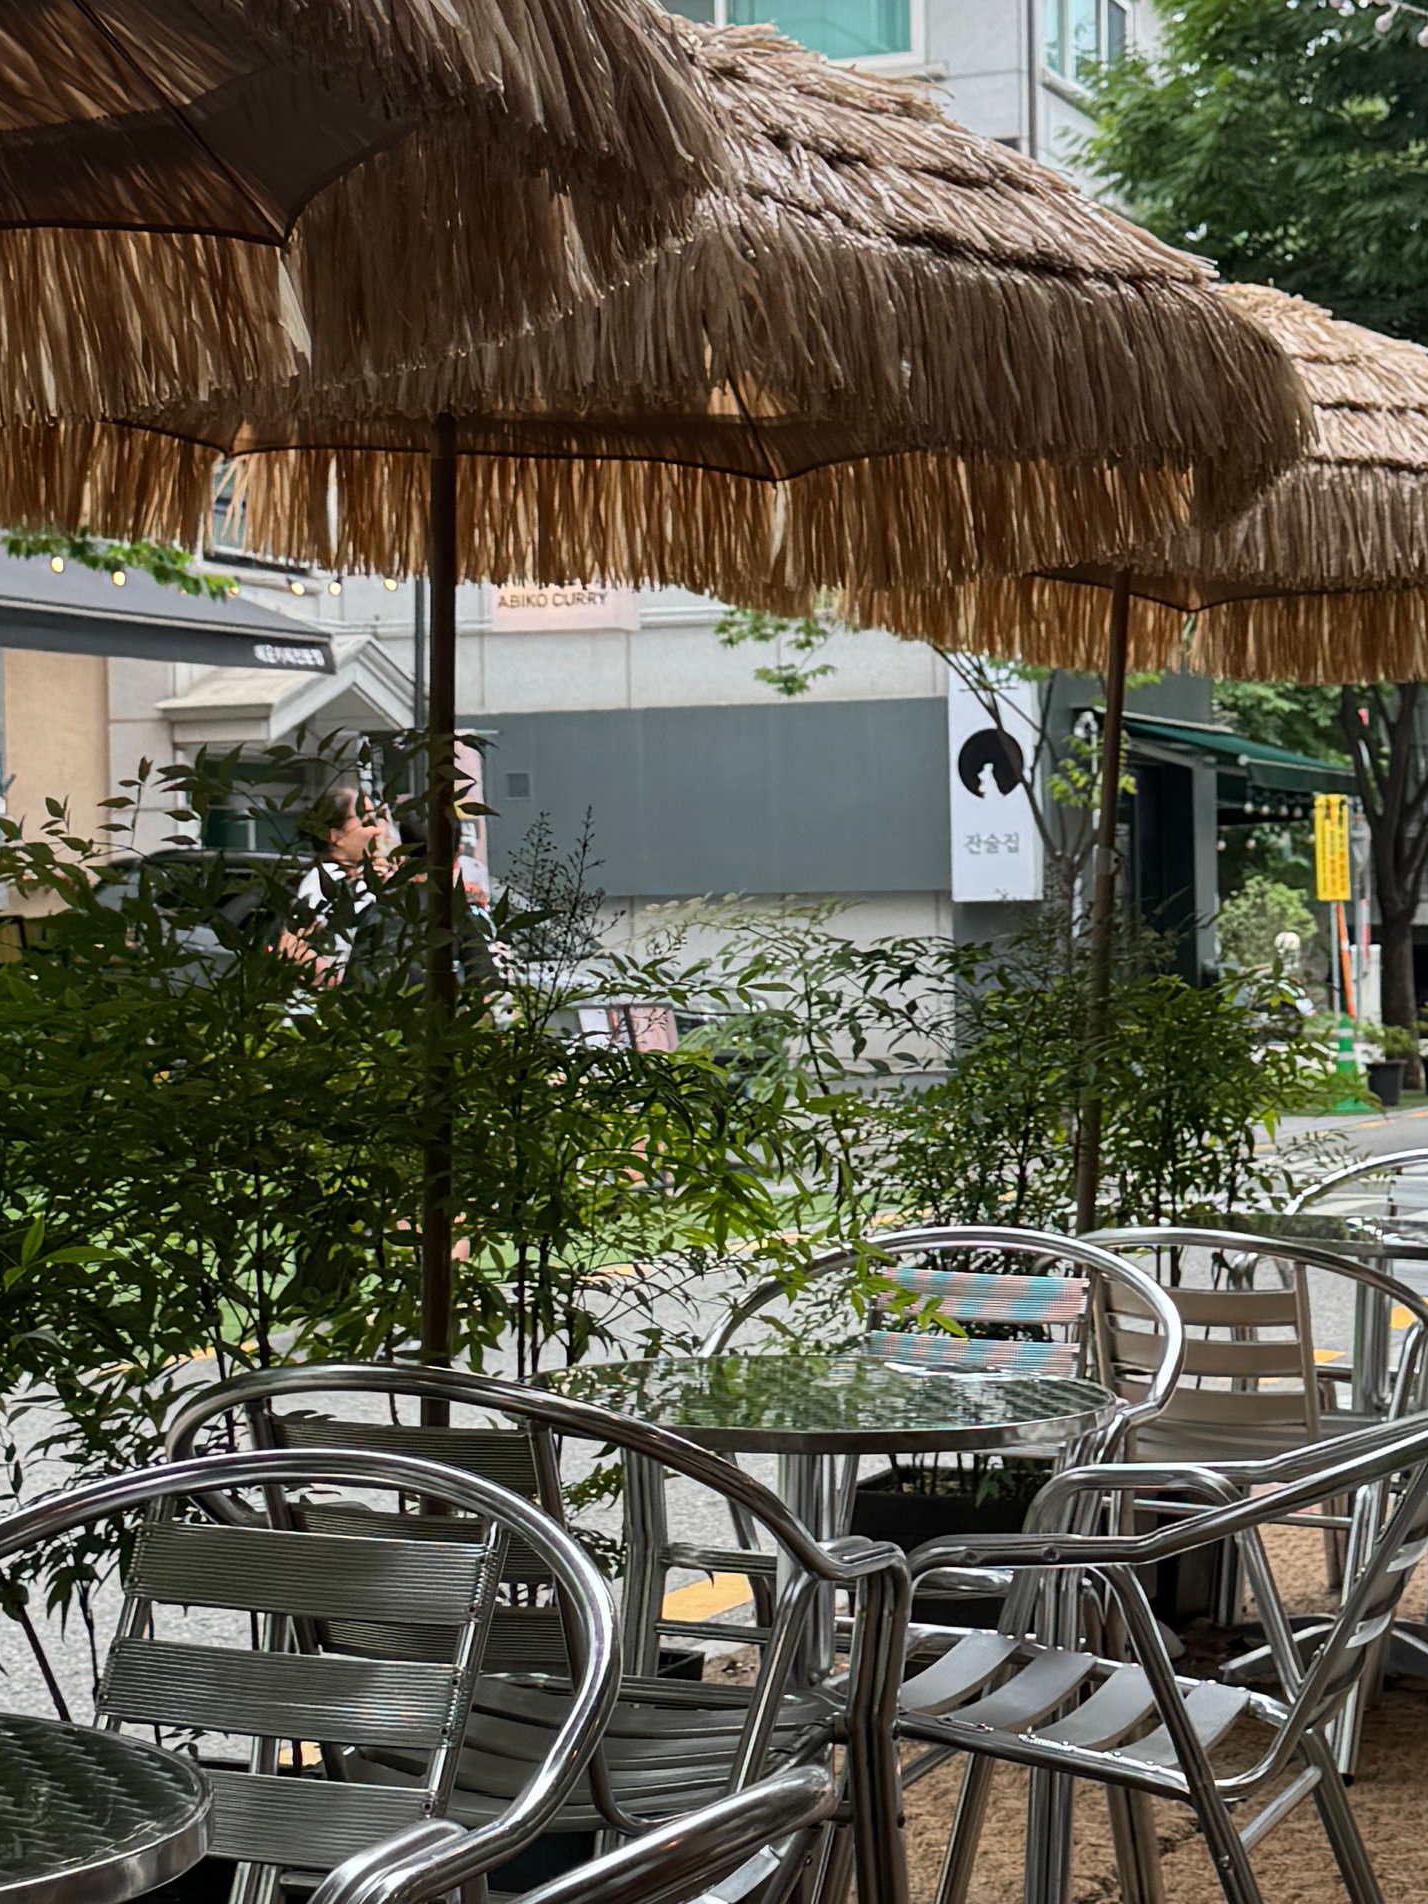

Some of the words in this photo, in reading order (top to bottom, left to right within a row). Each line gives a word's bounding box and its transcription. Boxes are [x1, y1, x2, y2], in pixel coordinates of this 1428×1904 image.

[498, 593, 548, 609] ABIKO
[552, 591, 608, 607] CURRY
[965, 831, 1020, 854] 잔술집
